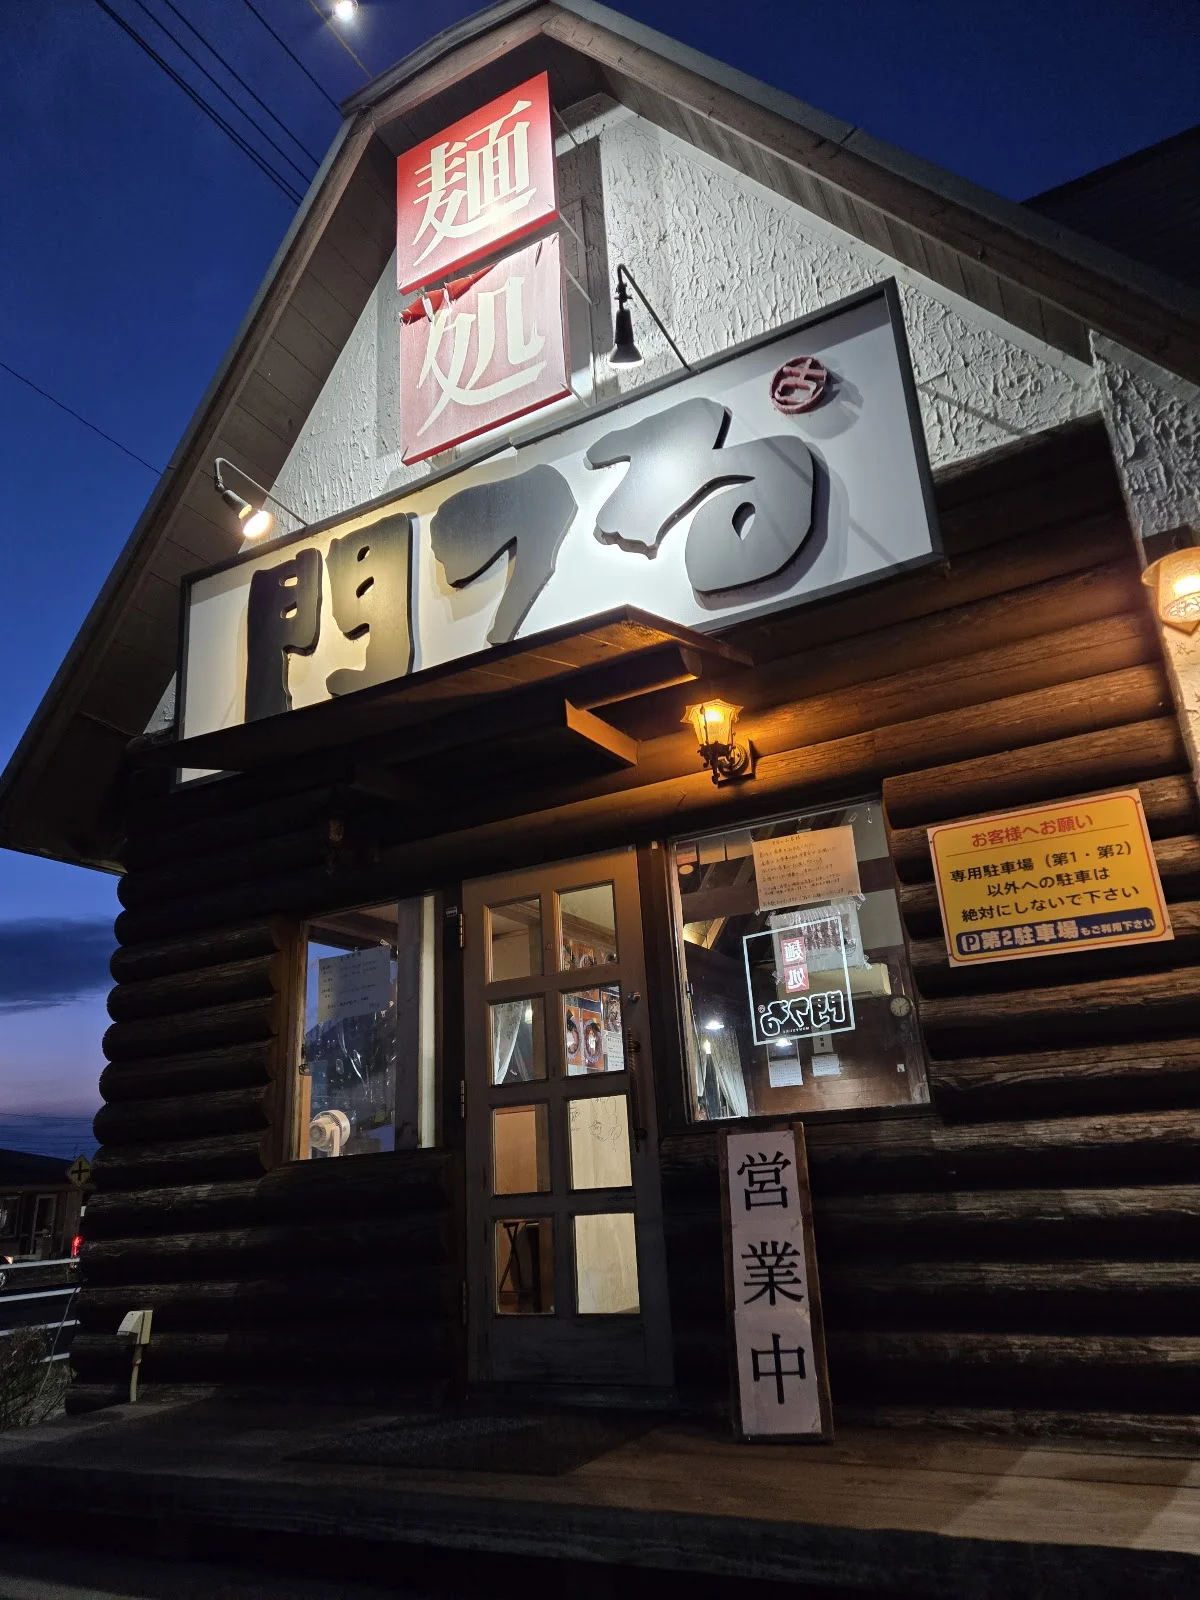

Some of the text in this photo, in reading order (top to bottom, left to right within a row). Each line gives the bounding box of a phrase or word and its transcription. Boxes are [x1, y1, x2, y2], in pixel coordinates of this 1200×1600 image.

[413, 100, 547, 437] 麺処
[971, 814, 1093, 848] お客様へお願い
[986, 866, 1110, 898] 以外への駐車は
[961, 885, 1140, 923] 絶対にしないで下さい
[736, 1150, 806, 1405] 営業中
